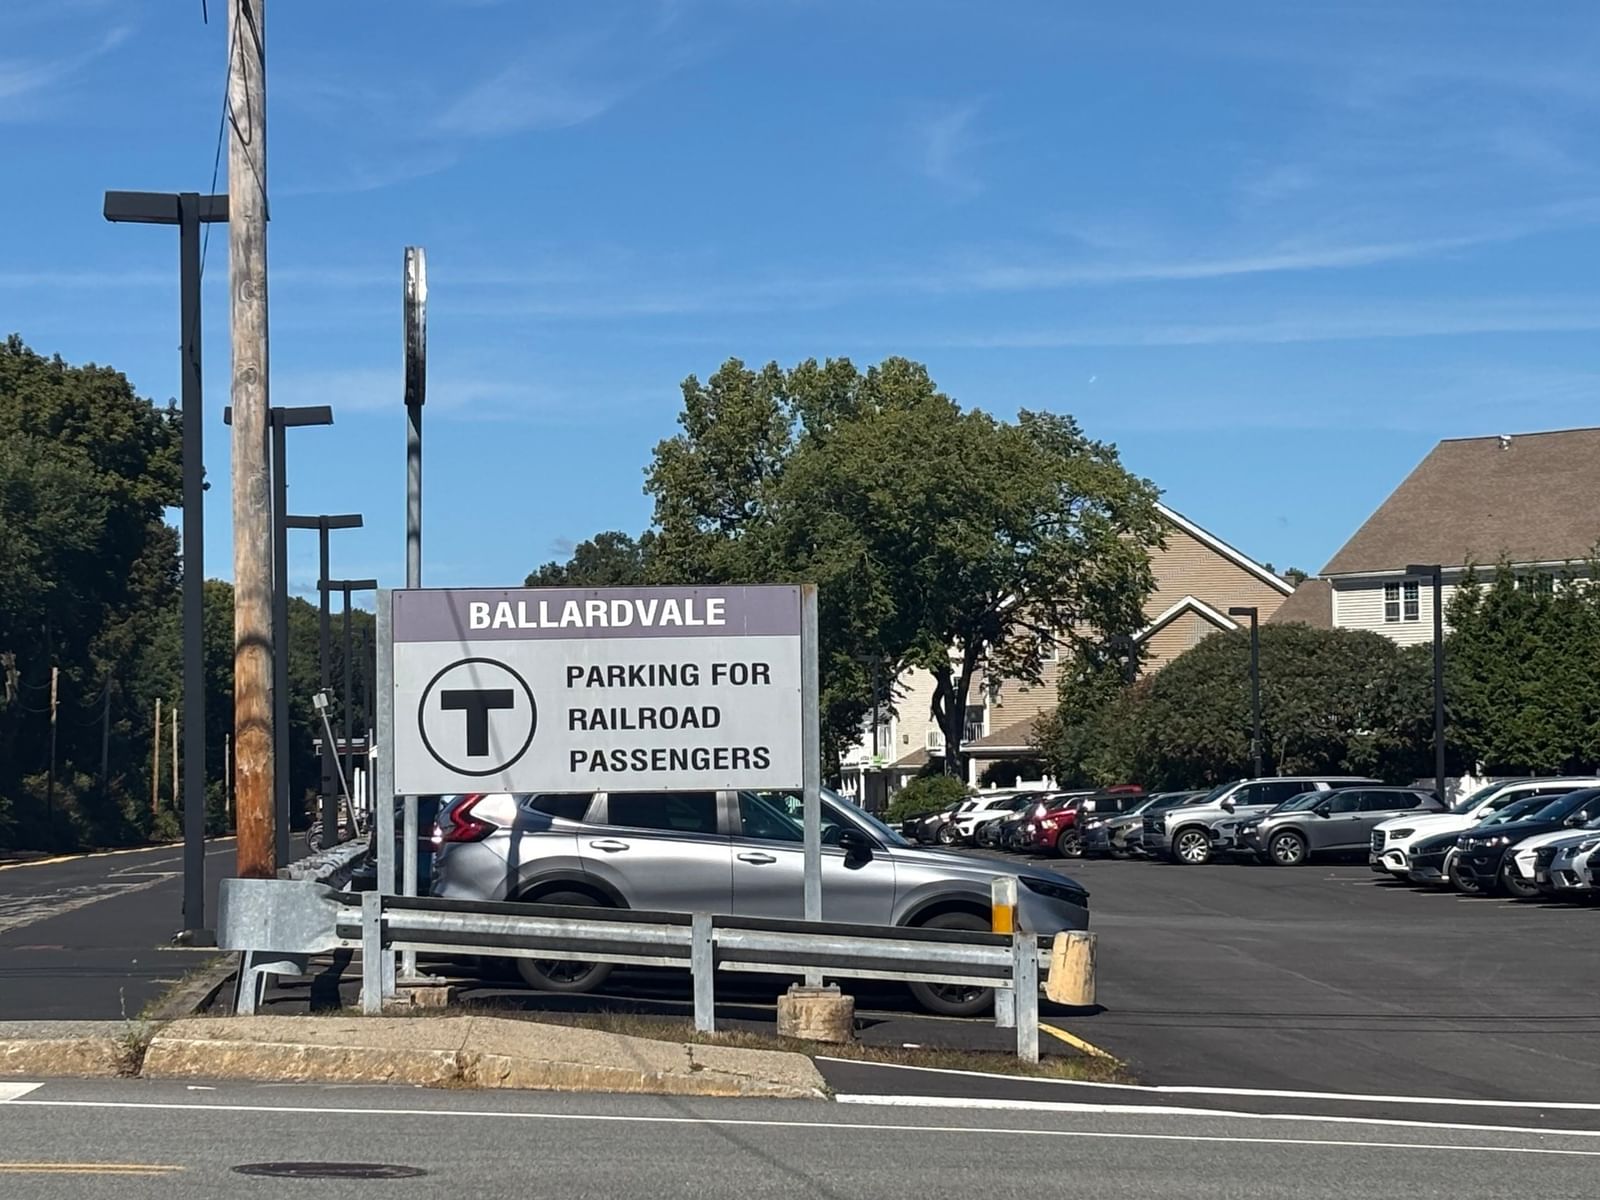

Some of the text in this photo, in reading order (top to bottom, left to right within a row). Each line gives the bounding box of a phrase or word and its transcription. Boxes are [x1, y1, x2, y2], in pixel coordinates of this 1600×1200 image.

[469, 598, 727, 630] BALLARDVALE
[566, 662, 771, 688] PARKING FOR
[440, 689, 514, 757] T
[568, 706, 721, 731] RAILROAD
[570, 746, 770, 772] PASSENGERS
